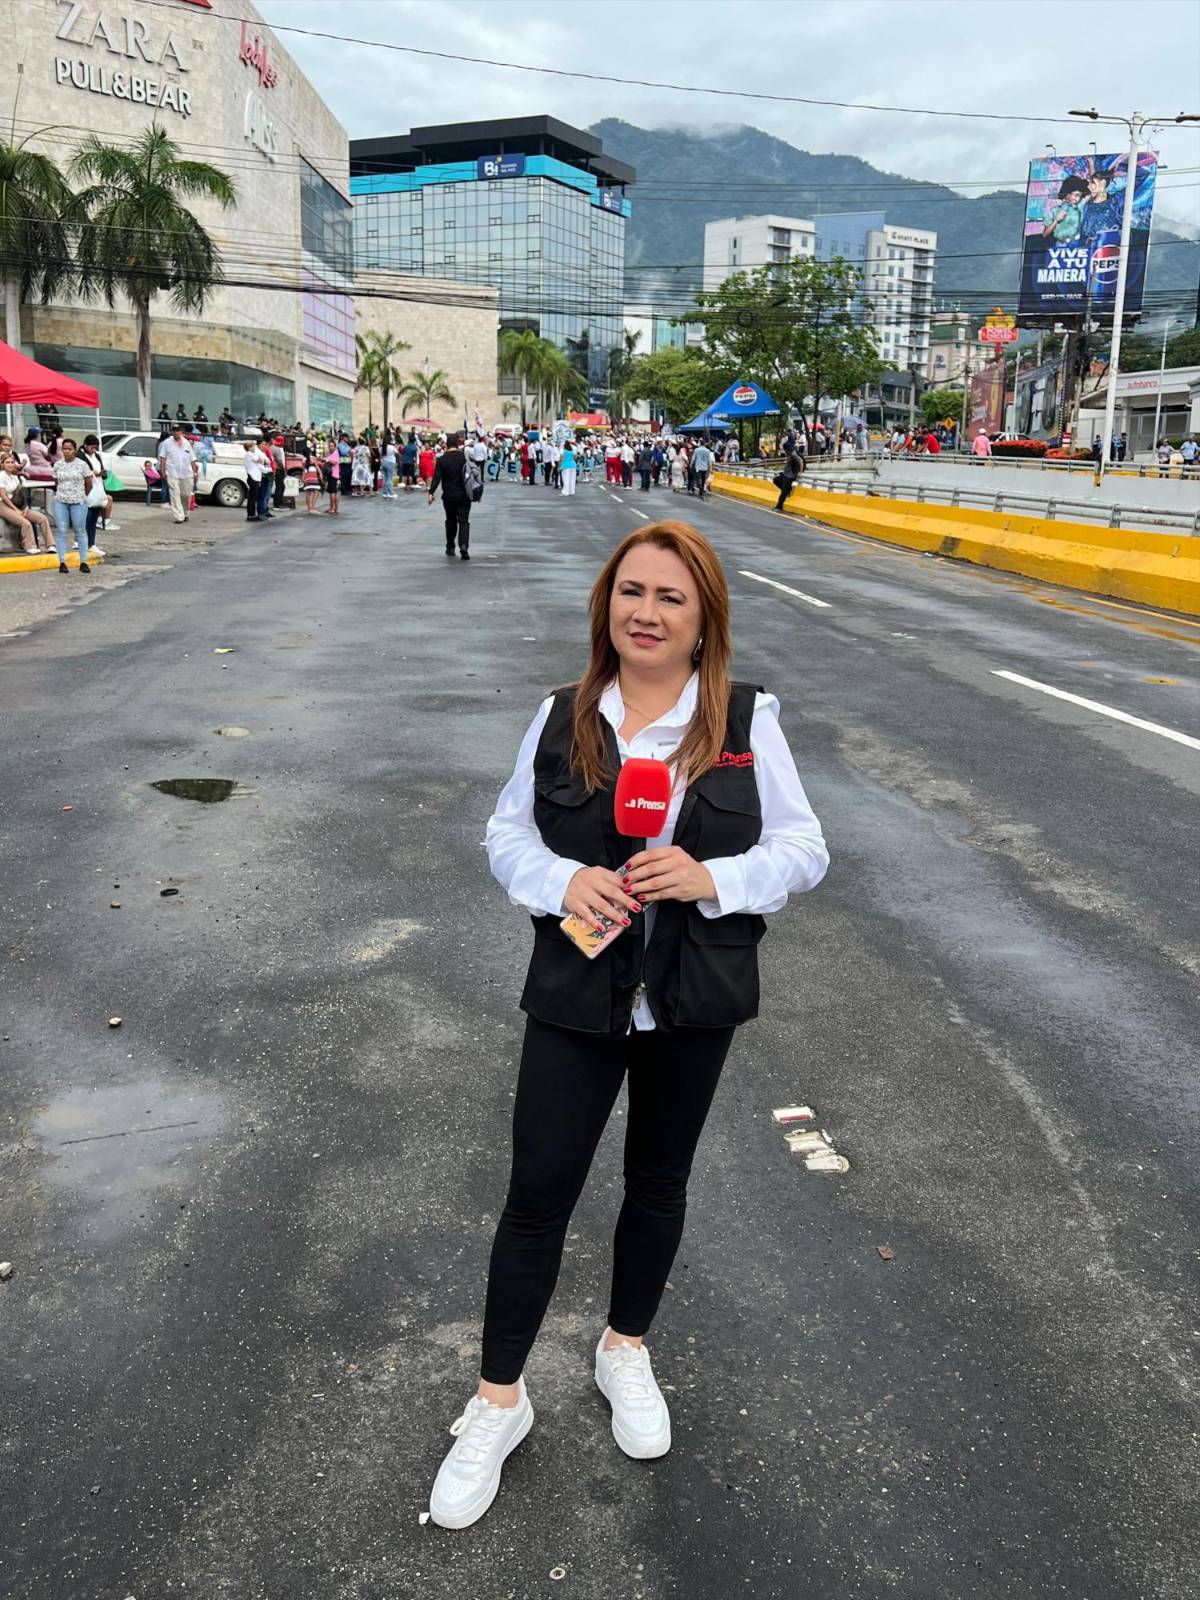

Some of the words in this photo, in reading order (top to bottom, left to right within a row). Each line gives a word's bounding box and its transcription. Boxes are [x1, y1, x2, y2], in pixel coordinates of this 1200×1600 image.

[55, 0, 192, 72] ZARA
[55, 57, 192, 115] PULL&BEAR
[1048, 249, 1089, 258] VIVE
[1048, 259, 1061, 268] A
[1062, 258, 1087, 268] TU
[1037, 269, 1087, 283] MANERA
[637, 797, 666, 810] Prensa
